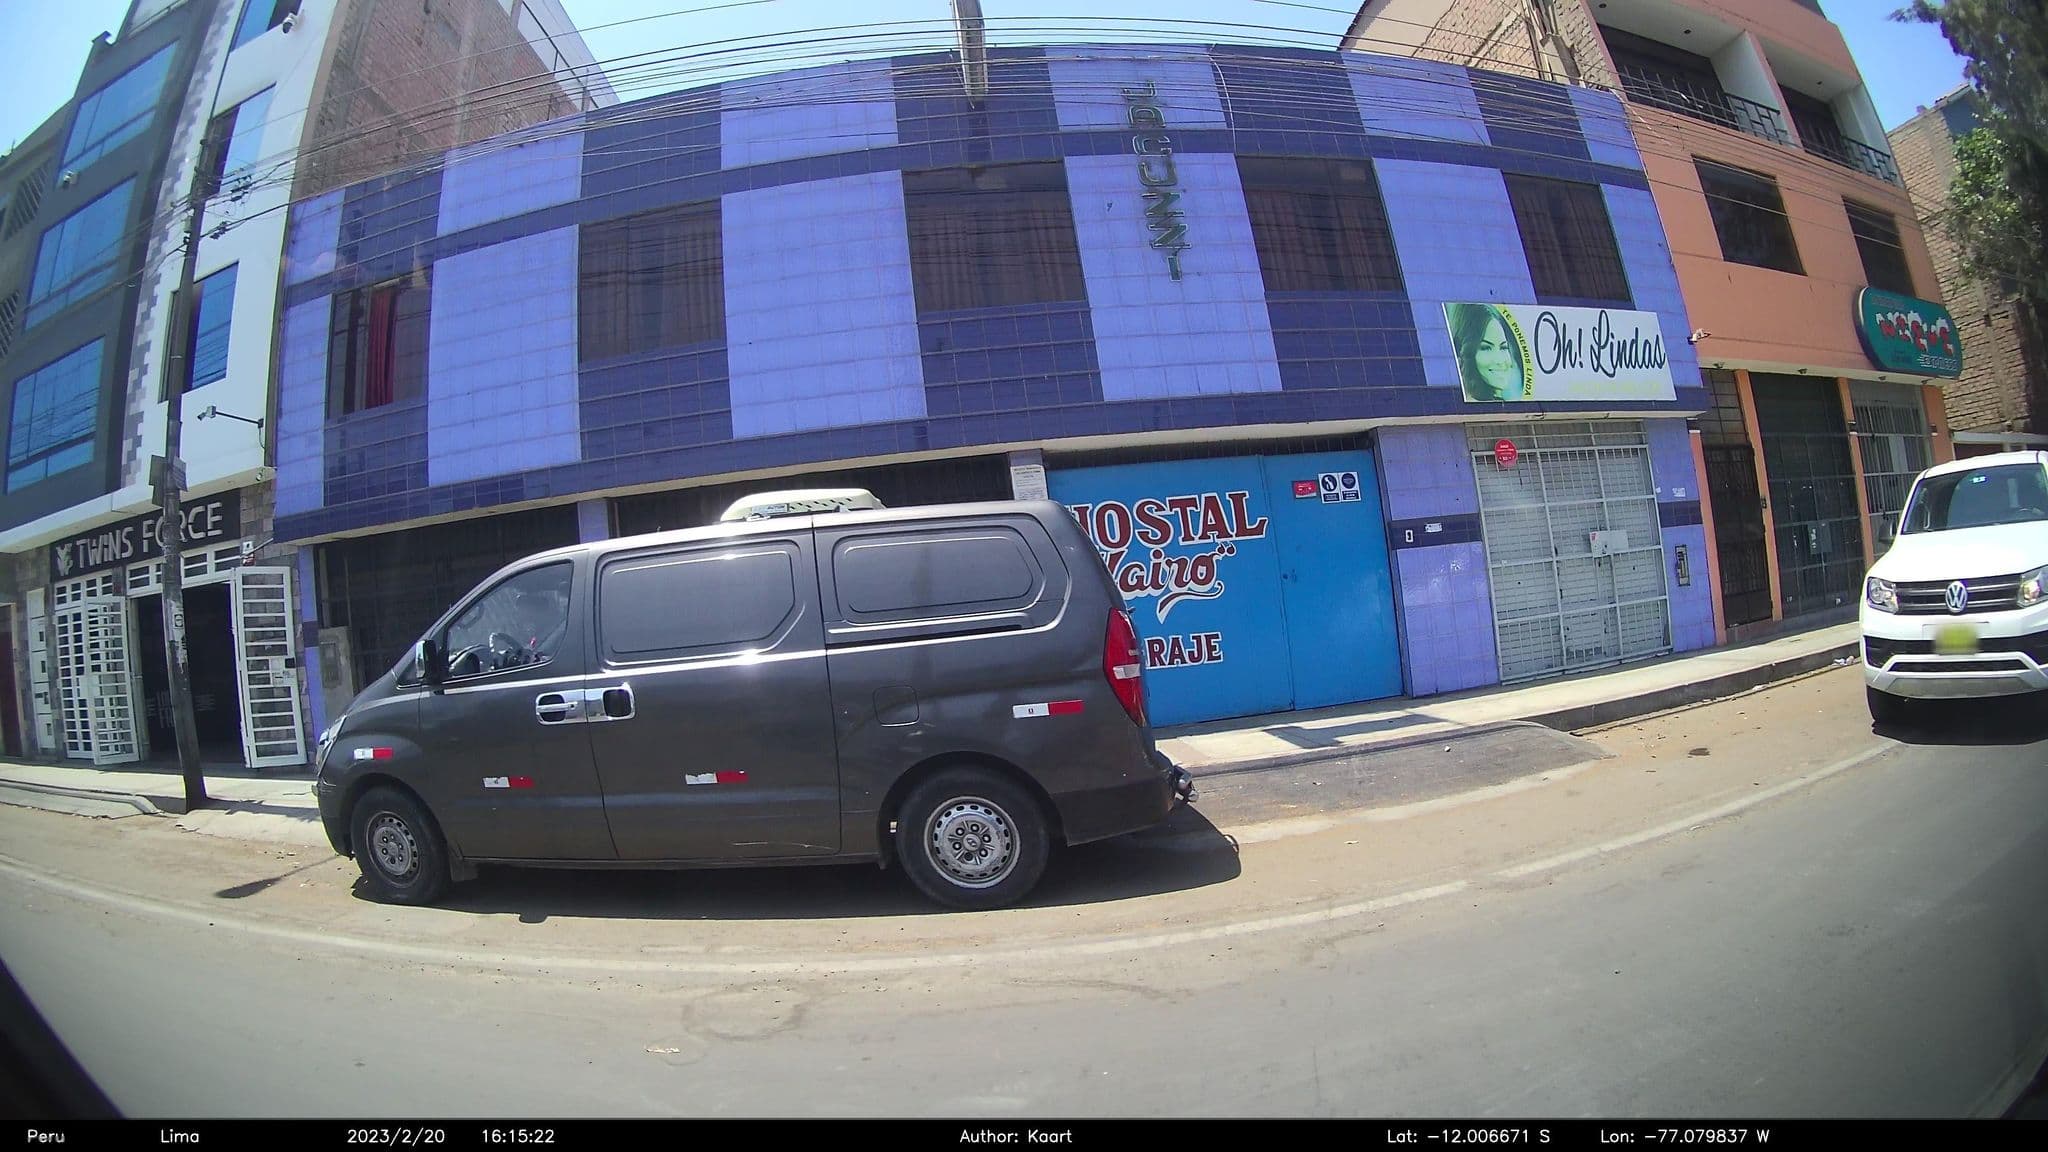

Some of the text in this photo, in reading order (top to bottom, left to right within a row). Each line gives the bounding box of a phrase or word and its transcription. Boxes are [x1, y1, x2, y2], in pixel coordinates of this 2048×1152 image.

[1533, 309, 1667, 378] Oh! Lindas
[1523, 367, 1533, 396] LINDA
[76, 526, 134, 569] TWINS
[1144, 631, 1225, 670] RAJE
